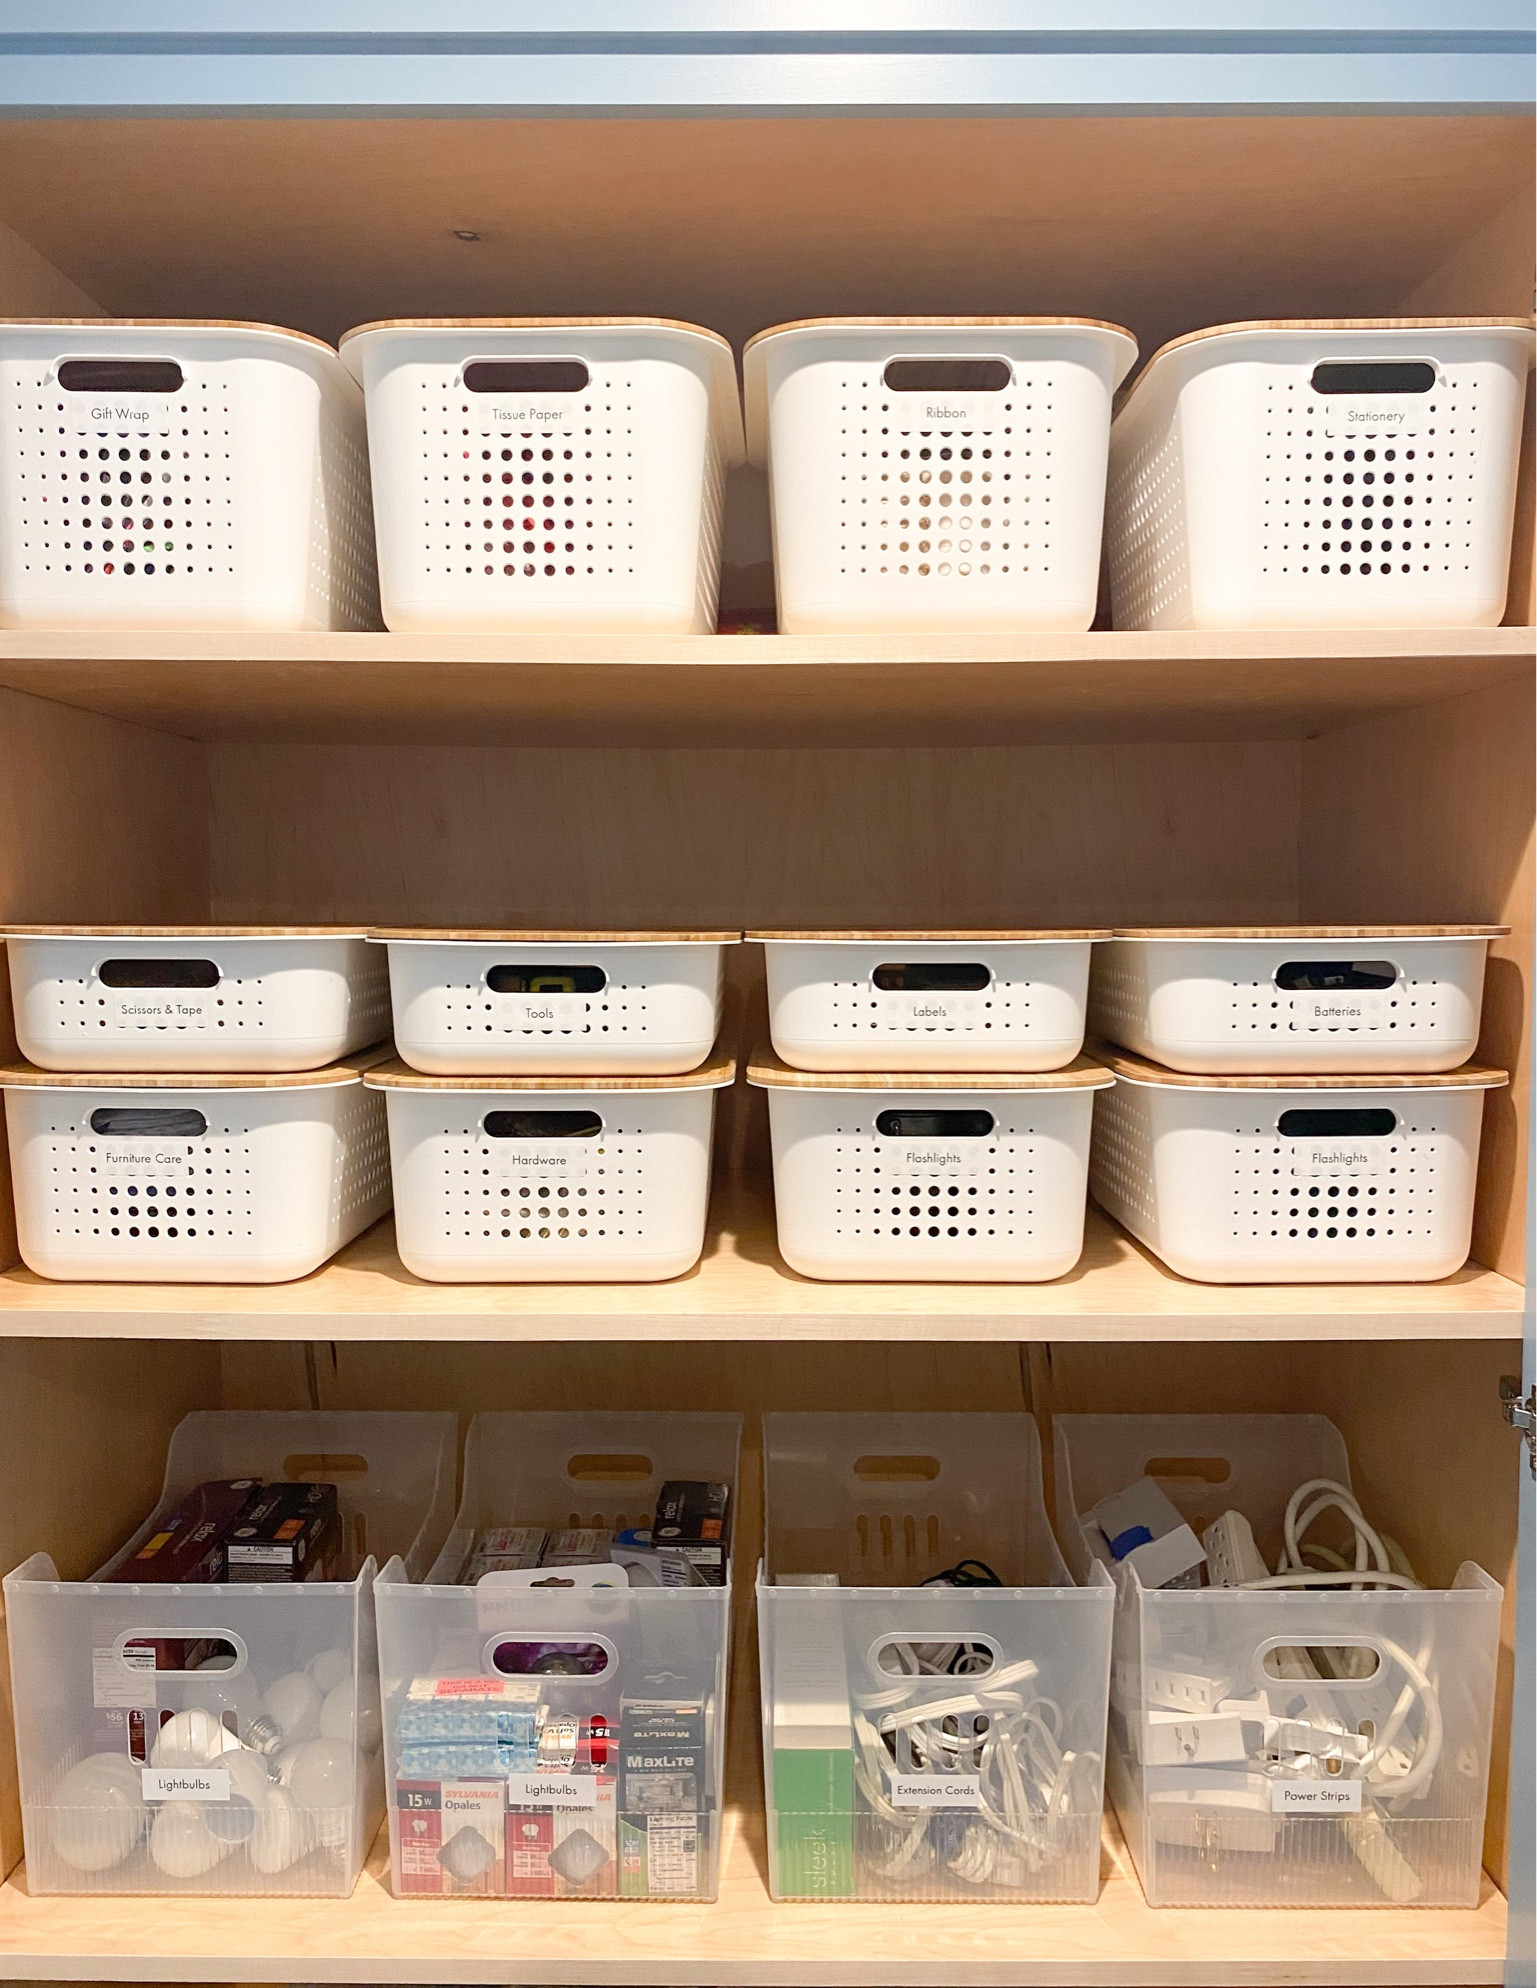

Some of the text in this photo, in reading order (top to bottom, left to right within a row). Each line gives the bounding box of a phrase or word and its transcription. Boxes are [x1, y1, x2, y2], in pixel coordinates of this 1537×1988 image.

[91, 407, 150, 423] Gift Wrap
[492, 408, 563, 423] Tissue Paper
[926, 406, 967, 419] Ribbon
[1347, 410, 1405, 424] Stationery
[121, 1004, 203, 1017] Scissors & Tape
[525, 1007, 554, 1019] Tools
[913, 1005, 947, 1017] Labels
[1314, 1005, 1362, 1017] Batteries
[106, 1152, 182, 1164] Furniture Care
[512, 1154, 567, 1165] Hardware
[906, 1152, 962, 1166] Flashlights
[1312, 1152, 1368, 1166] Flashlights
[158, 1778, 211, 1792] Lightbulbs
[525, 1784, 578, 1797] Lightbulbs
[897, 1785, 976, 1796] Extension Cords
[445, 1790, 499, 1799] SYLVANIA
[1284, 1790, 1350, 1803] Power Strips
[445, 1800, 482, 1812] Opales
[803, 1828, 827, 1888] sleek
